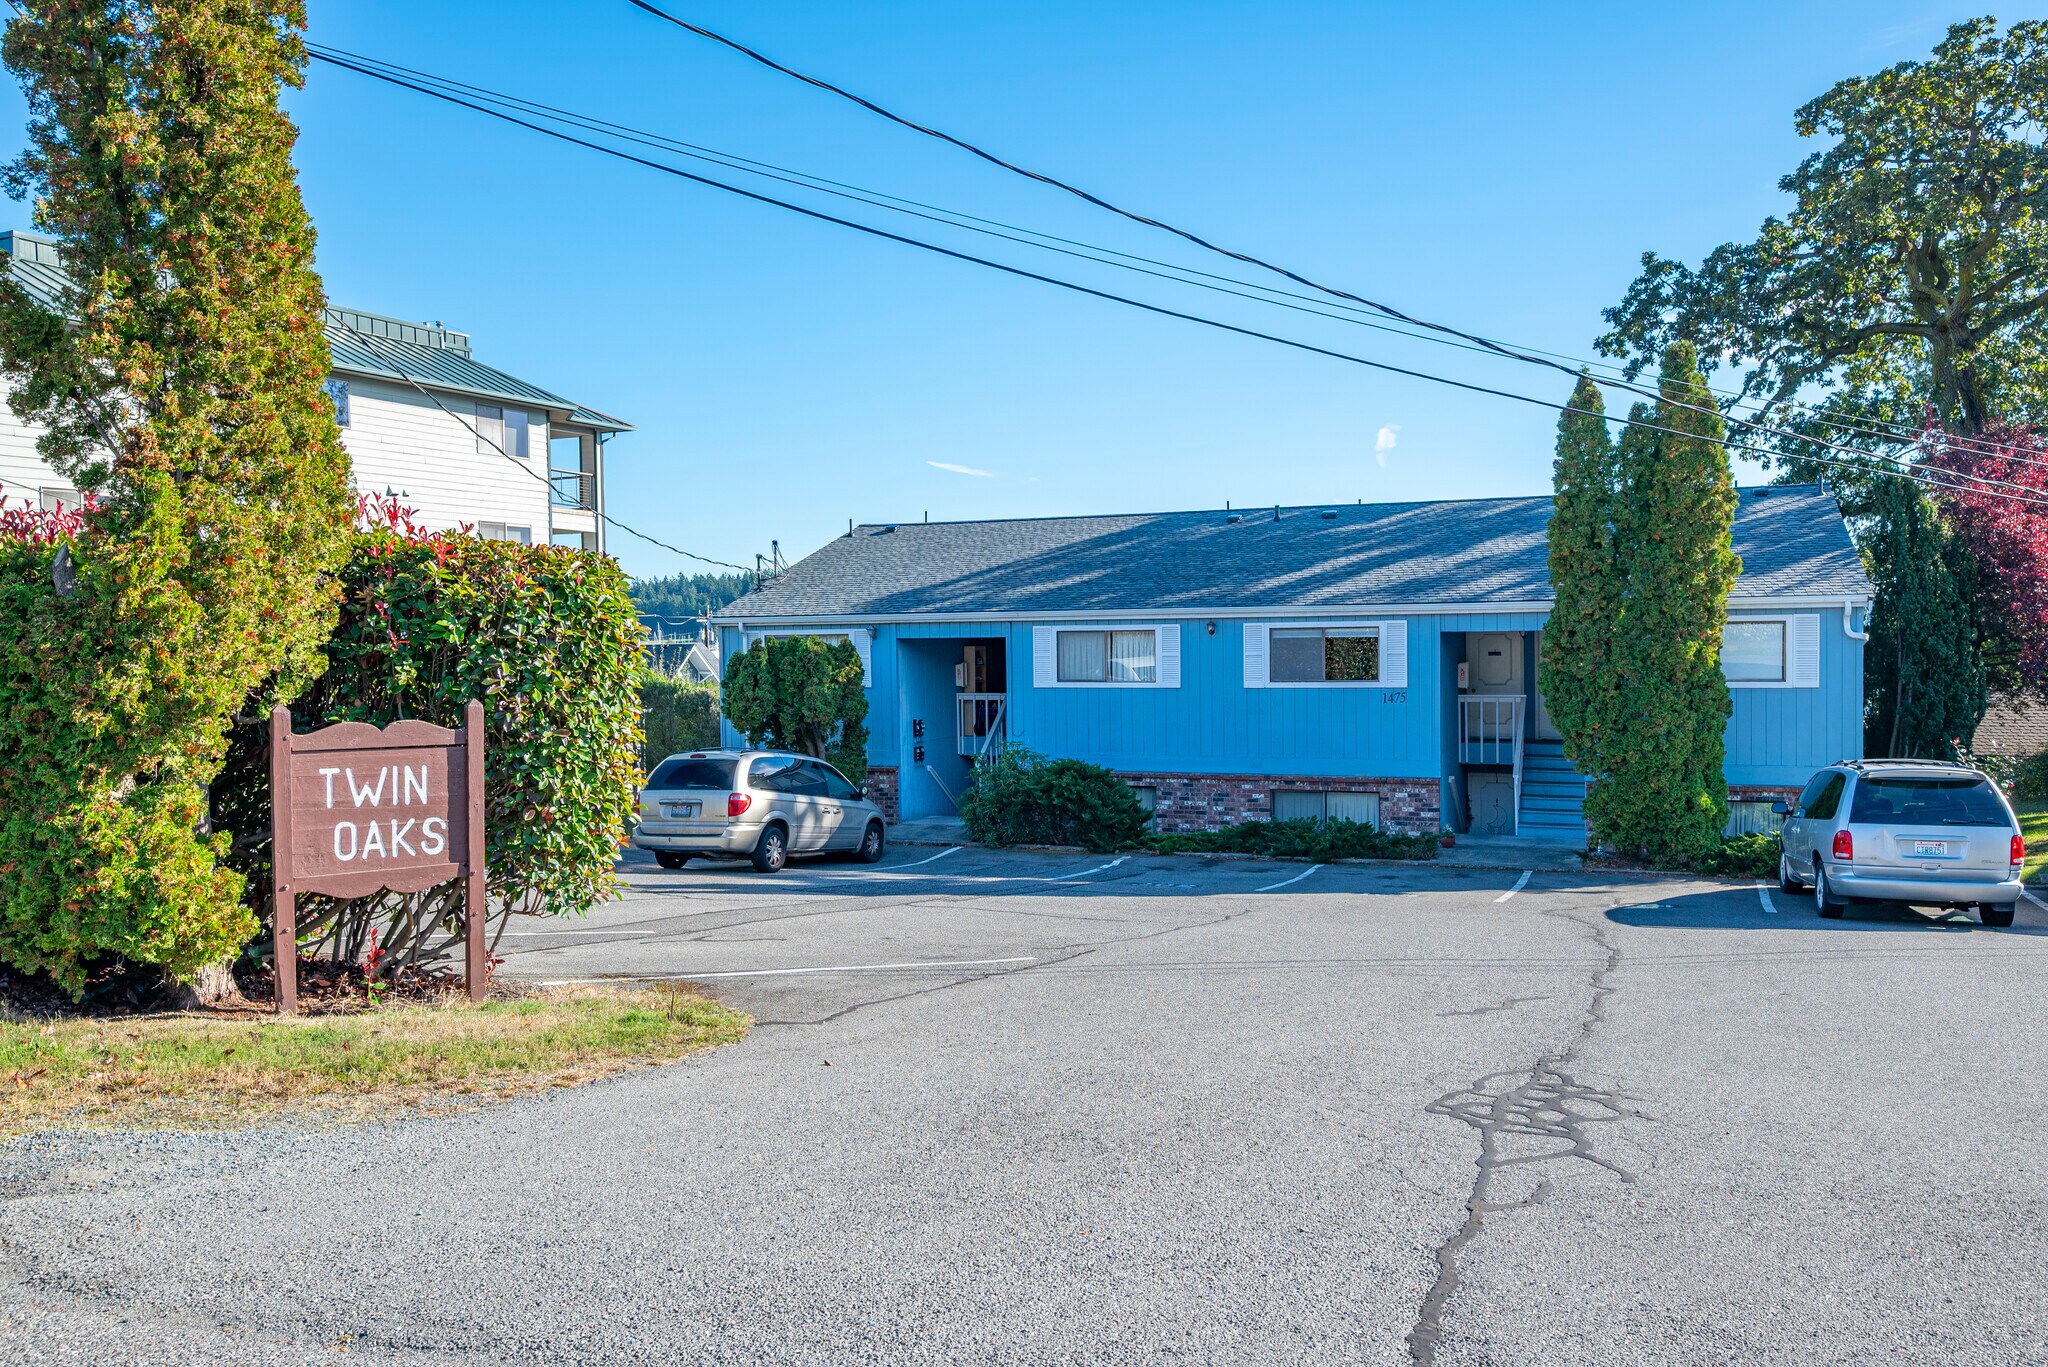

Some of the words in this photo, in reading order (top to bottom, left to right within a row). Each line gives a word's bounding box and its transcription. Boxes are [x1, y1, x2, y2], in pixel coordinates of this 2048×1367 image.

[1383, 692, 1406, 704] 1475
[319, 764, 428, 809] TWIN
[334, 817, 447, 861] OAKS
